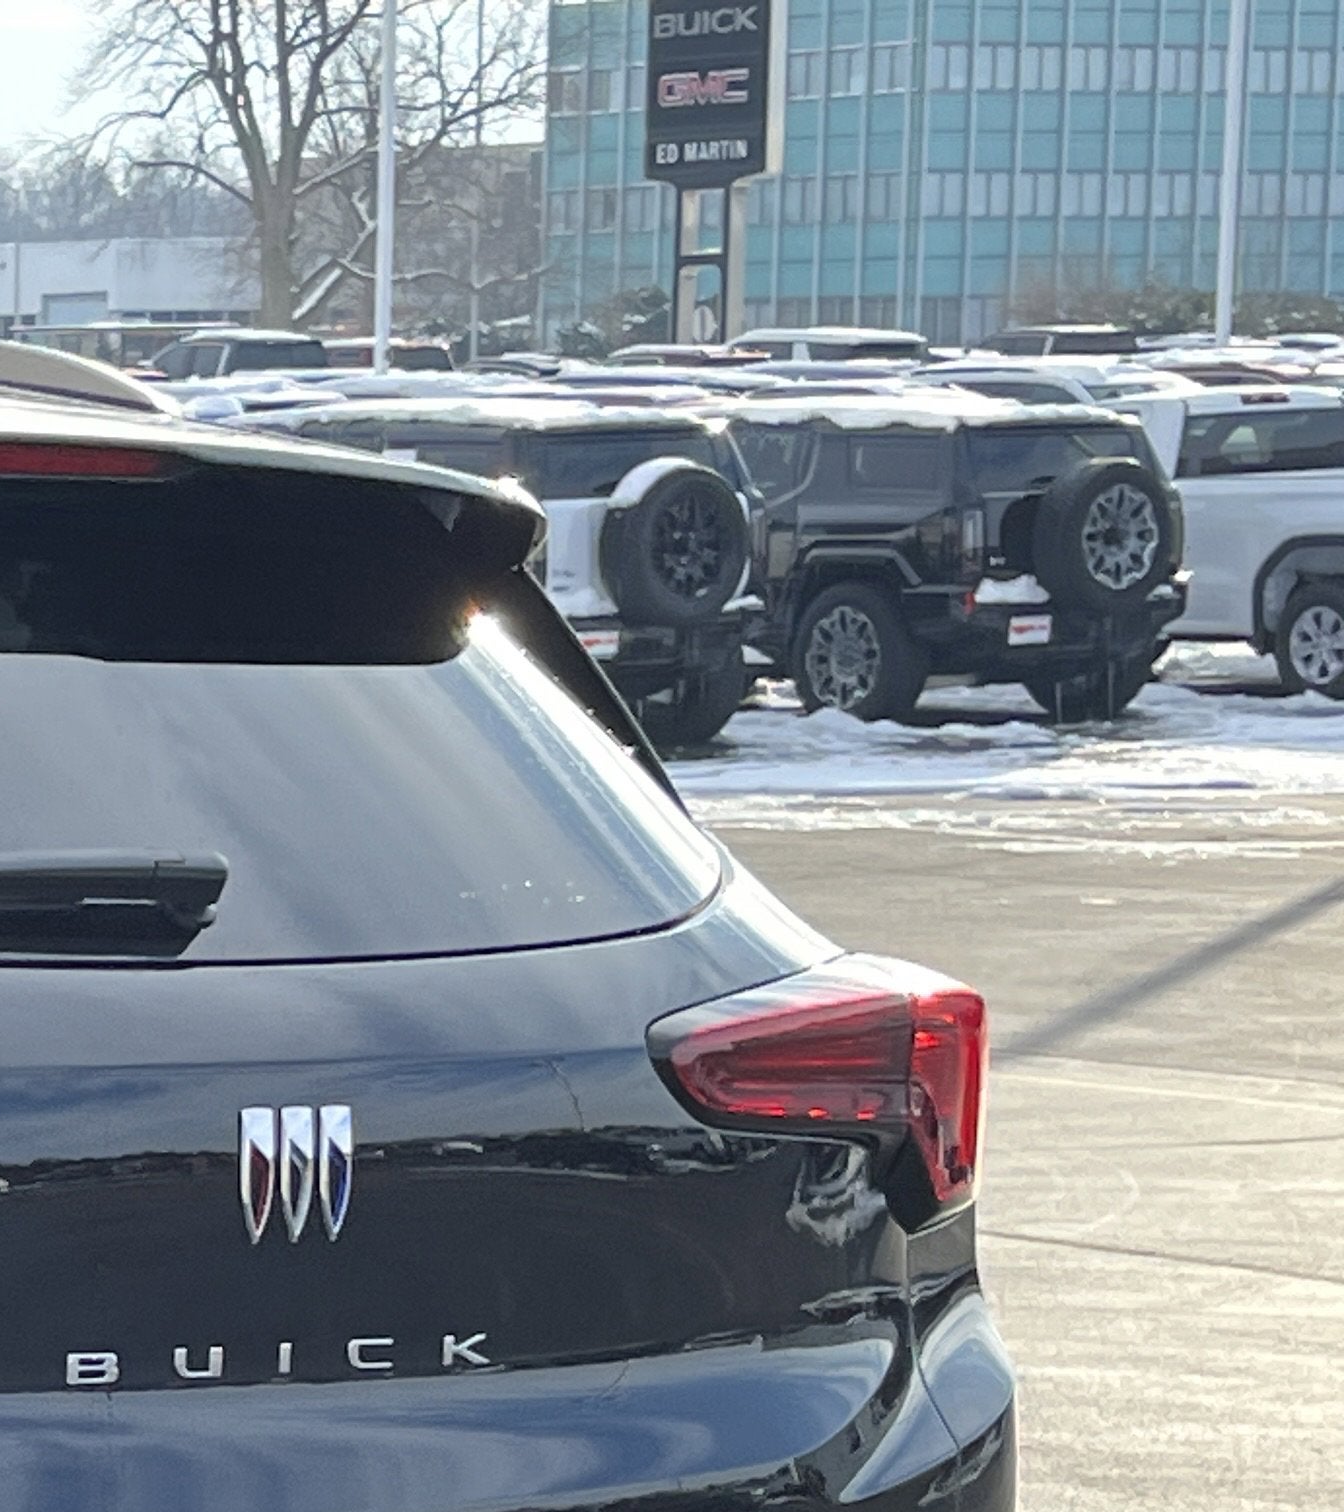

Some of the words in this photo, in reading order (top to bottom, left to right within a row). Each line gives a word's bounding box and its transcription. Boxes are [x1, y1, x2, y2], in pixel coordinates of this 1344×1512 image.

[653, 5, 758, 39] BUICK
[657, 68, 749, 108] GMC
[655, 142, 679, 164] ED
[683, 139, 748, 162] MARTIN
[64, 1332, 492, 1386] BUICK
